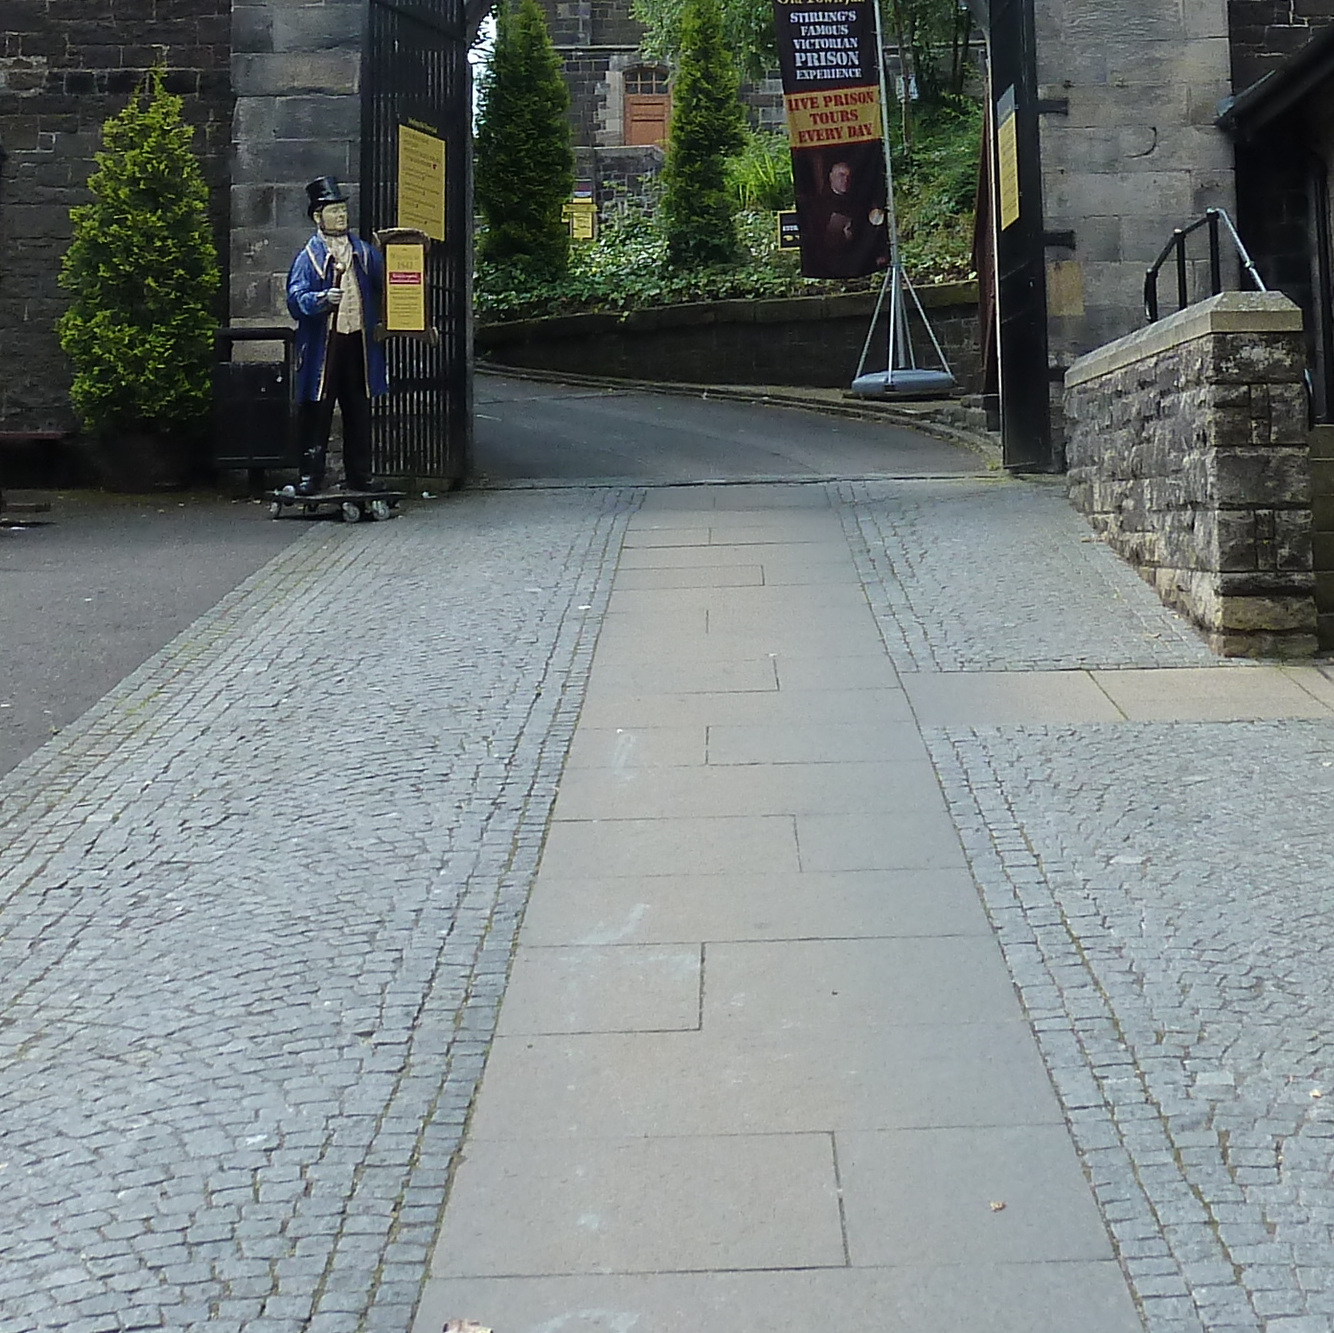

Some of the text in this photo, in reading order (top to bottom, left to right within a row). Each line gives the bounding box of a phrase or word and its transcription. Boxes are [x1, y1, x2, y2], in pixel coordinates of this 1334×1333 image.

[789, 10, 857, 24] STIRLING'S
[800, 24, 849, 36] FAMOUS
[793, 37, 858, 50] VICTORIAN
[794, 51, 860, 67] PRISON
[796, 68, 863, 80] EXPERIENCE
[788, 91, 875, 111] LIVE PRISON
[809, 109, 859, 125] TOURS
[798, 122, 873, 144] EVERY DAY
